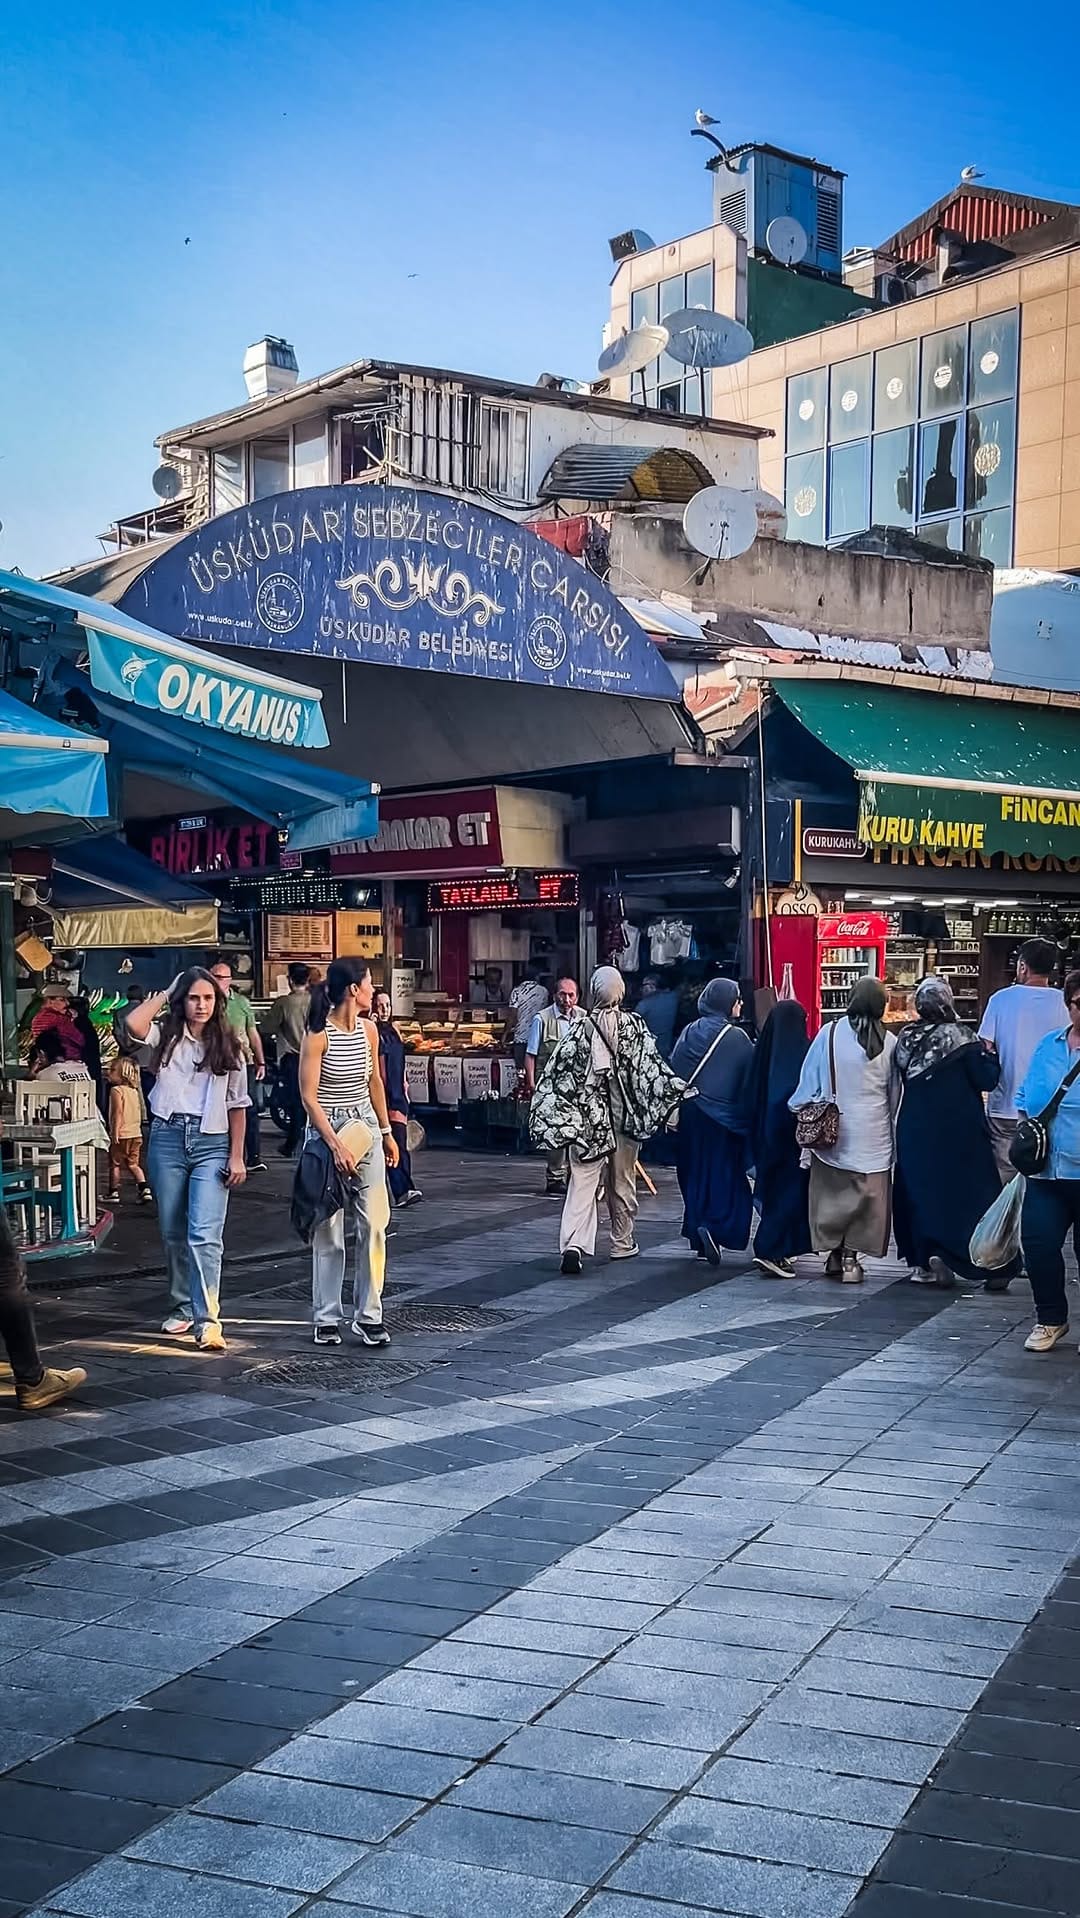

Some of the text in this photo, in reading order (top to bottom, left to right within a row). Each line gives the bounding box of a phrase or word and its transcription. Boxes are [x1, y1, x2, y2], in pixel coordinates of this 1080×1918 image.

[158, 663, 302, 743] OKYANUS
[457, 811, 491, 846] ET
[858, 815, 985, 849] KURU KAHVE
